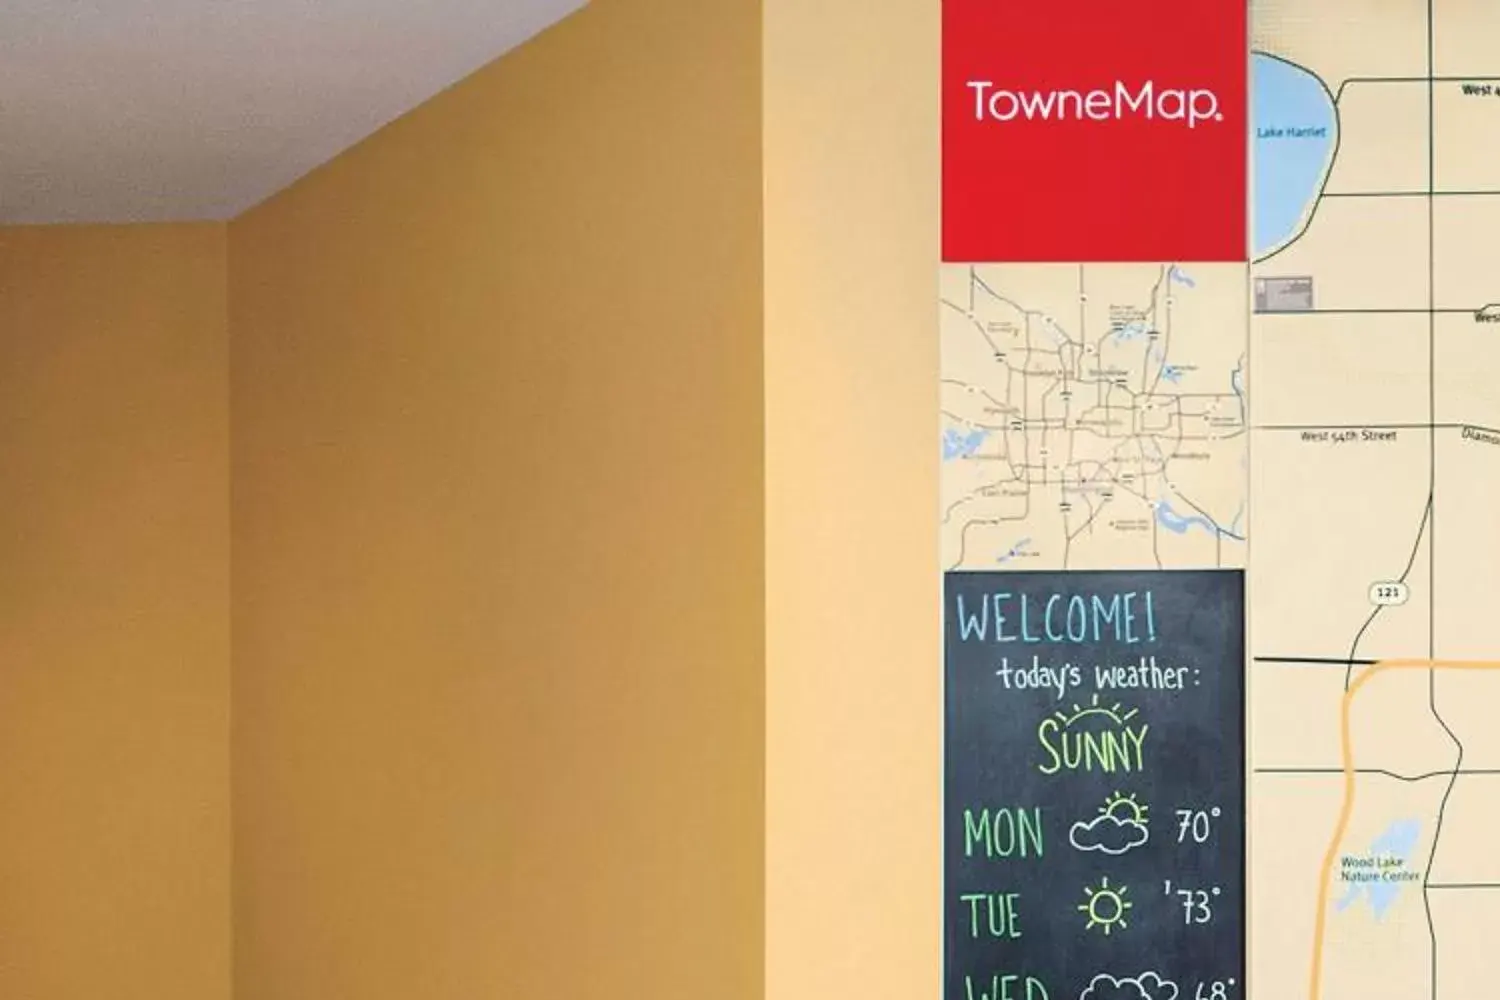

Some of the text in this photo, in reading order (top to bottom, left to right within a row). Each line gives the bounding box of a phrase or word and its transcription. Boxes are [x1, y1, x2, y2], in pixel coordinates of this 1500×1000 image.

[1462, 84, 1491, 95] West
[1257, 126, 1326, 138] Lake Harriet
[1301, 430, 1329, 441] West
[1361, 430, 1396, 441] Street
[1377, 587, 1399, 598] 121
[957, 591, 1156, 644] WELCOME!
[996, 656, 1200, 699] today's weather:
[1038, 719, 1149, 774] SUNNY
[963, 808, 1044, 858] MON
[1341, 857, 1403, 868] Wood Lake
[1341, 871, 1420, 882] Nature Center
[960, 893, 1022, 938] TUE
